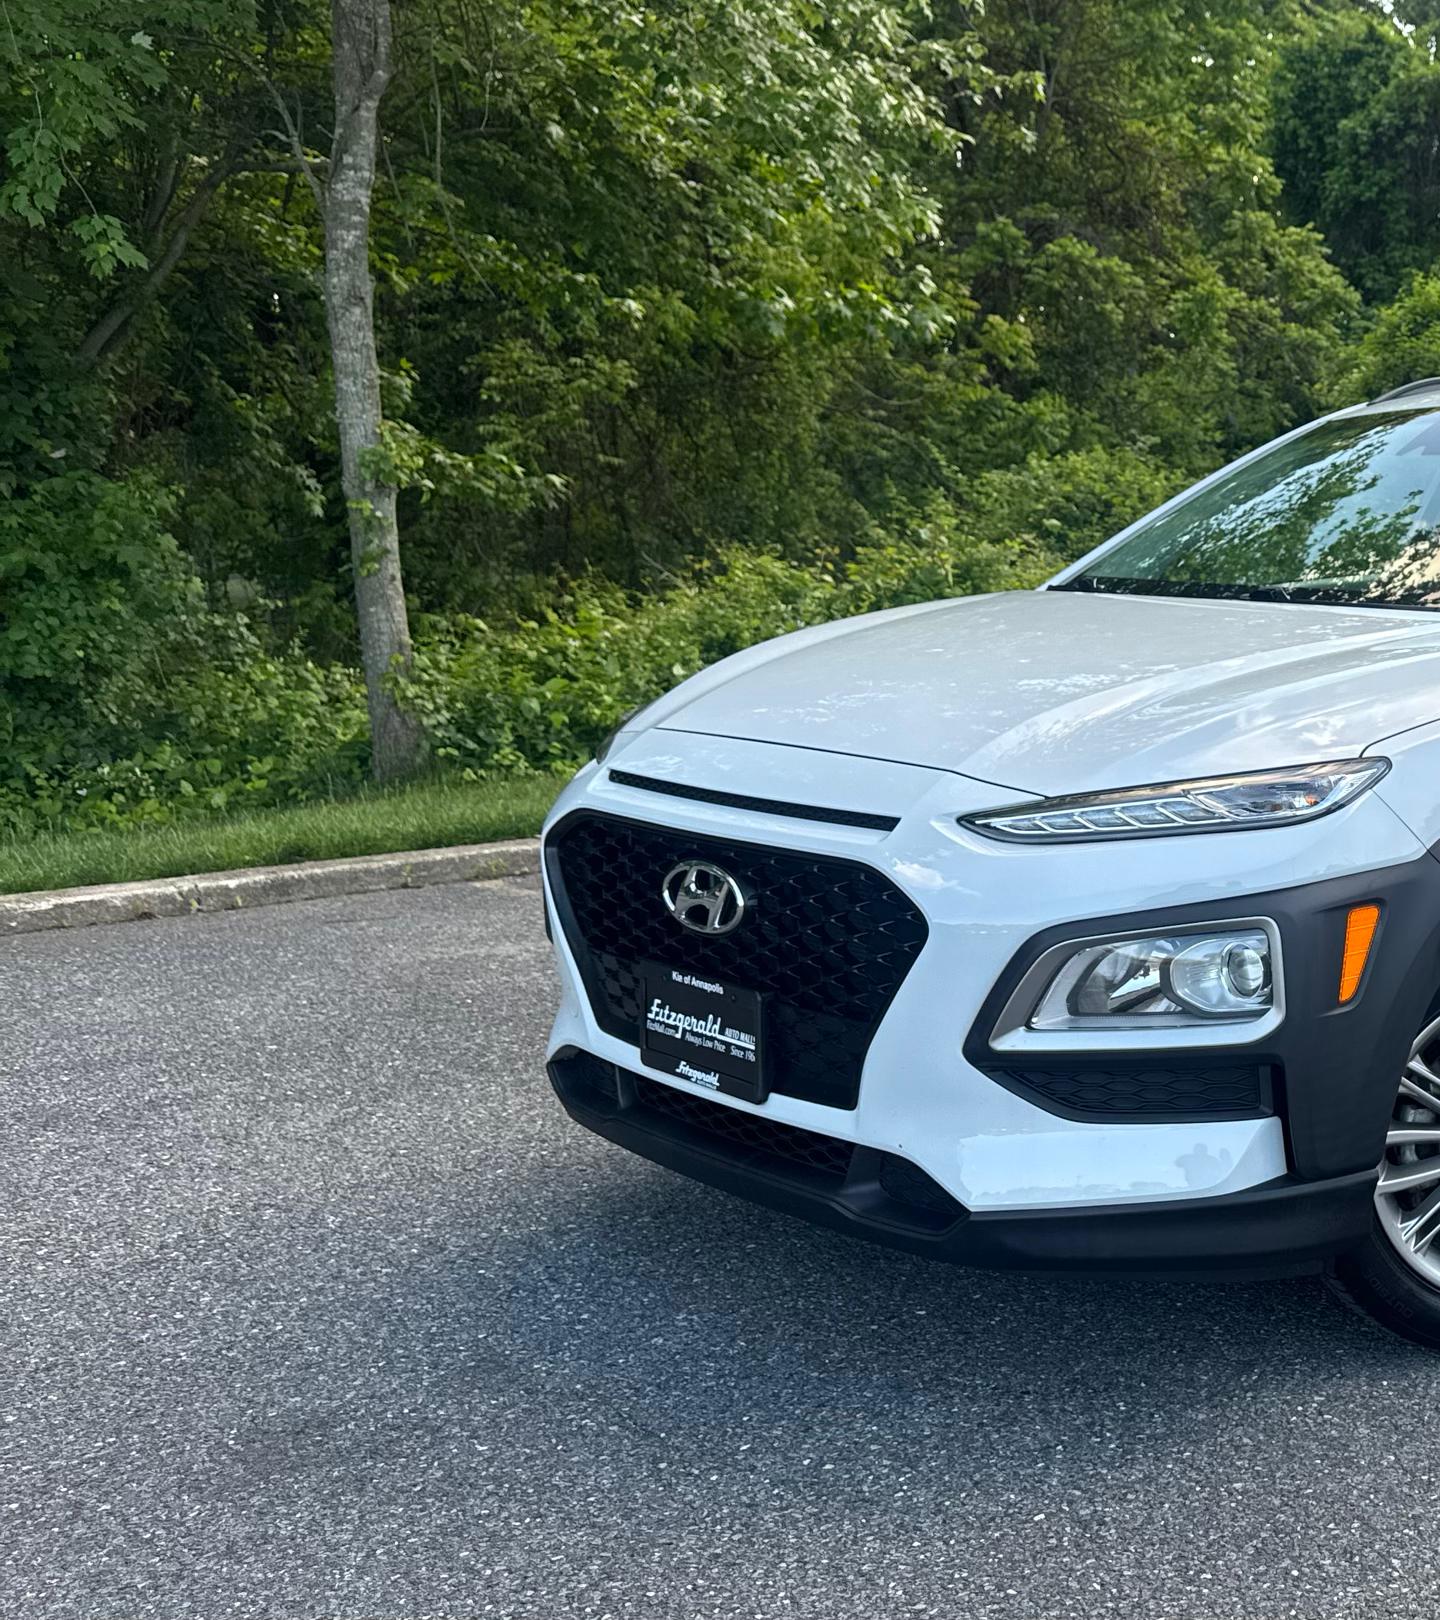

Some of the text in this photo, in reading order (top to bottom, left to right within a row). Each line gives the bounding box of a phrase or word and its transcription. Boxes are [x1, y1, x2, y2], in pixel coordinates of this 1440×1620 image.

[672, 971, 724, 994] Kia of Annapolis
[724, 1027, 740, 1039] AUTO
[684, 1032, 702, 1046] Always
[702, 1036, 713, 1048] Low
[714, 1040, 726, 1053] Price
[731, 1046, 744, 1058] Since
